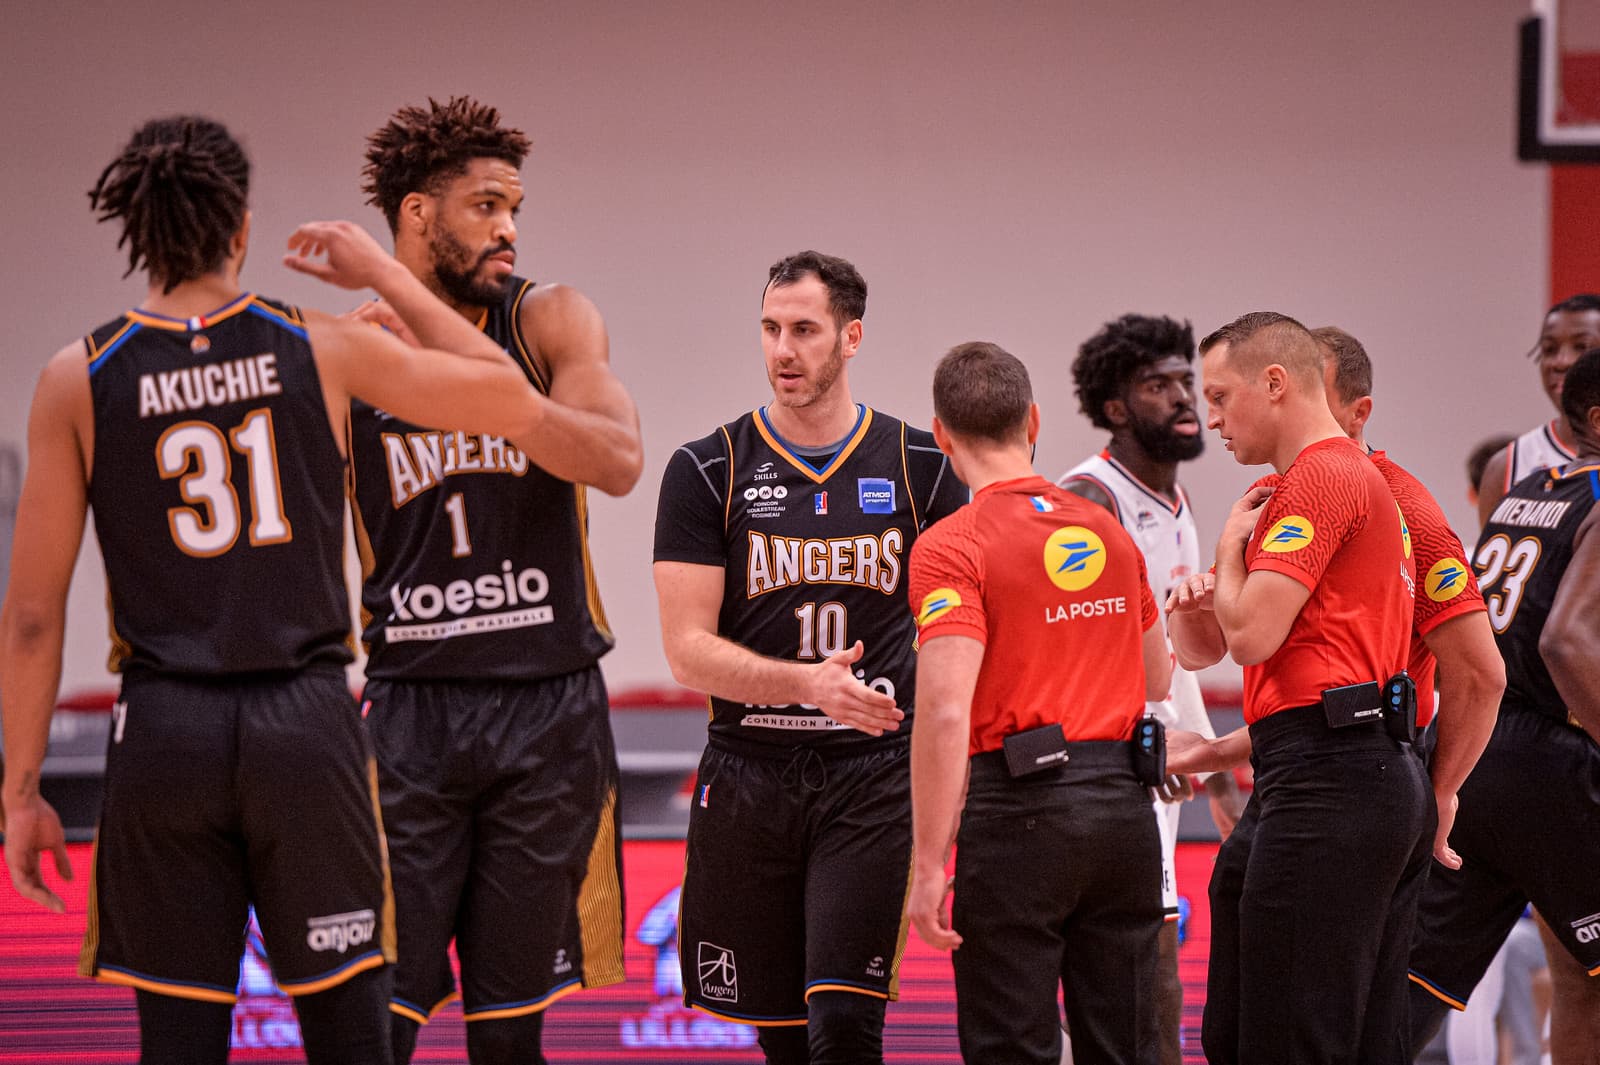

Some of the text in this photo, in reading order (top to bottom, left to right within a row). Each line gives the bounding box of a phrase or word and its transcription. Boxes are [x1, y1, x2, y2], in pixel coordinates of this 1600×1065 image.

[139, 353, 282, 418] AKUCHIE
[155, 407, 293, 558] 31
[753, 472, 778, 481] SKILLS
[445, 492, 472, 558] 1
[747, 527, 903, 600] ANGERS
[1475, 533, 1542, 634] 23
[795, 602, 848, 660] 10
[1046, 597, 1126, 623] LA POSTE
[747, 717, 817, 728] CONNEXION
[703, 982, 735, 996] Angers
